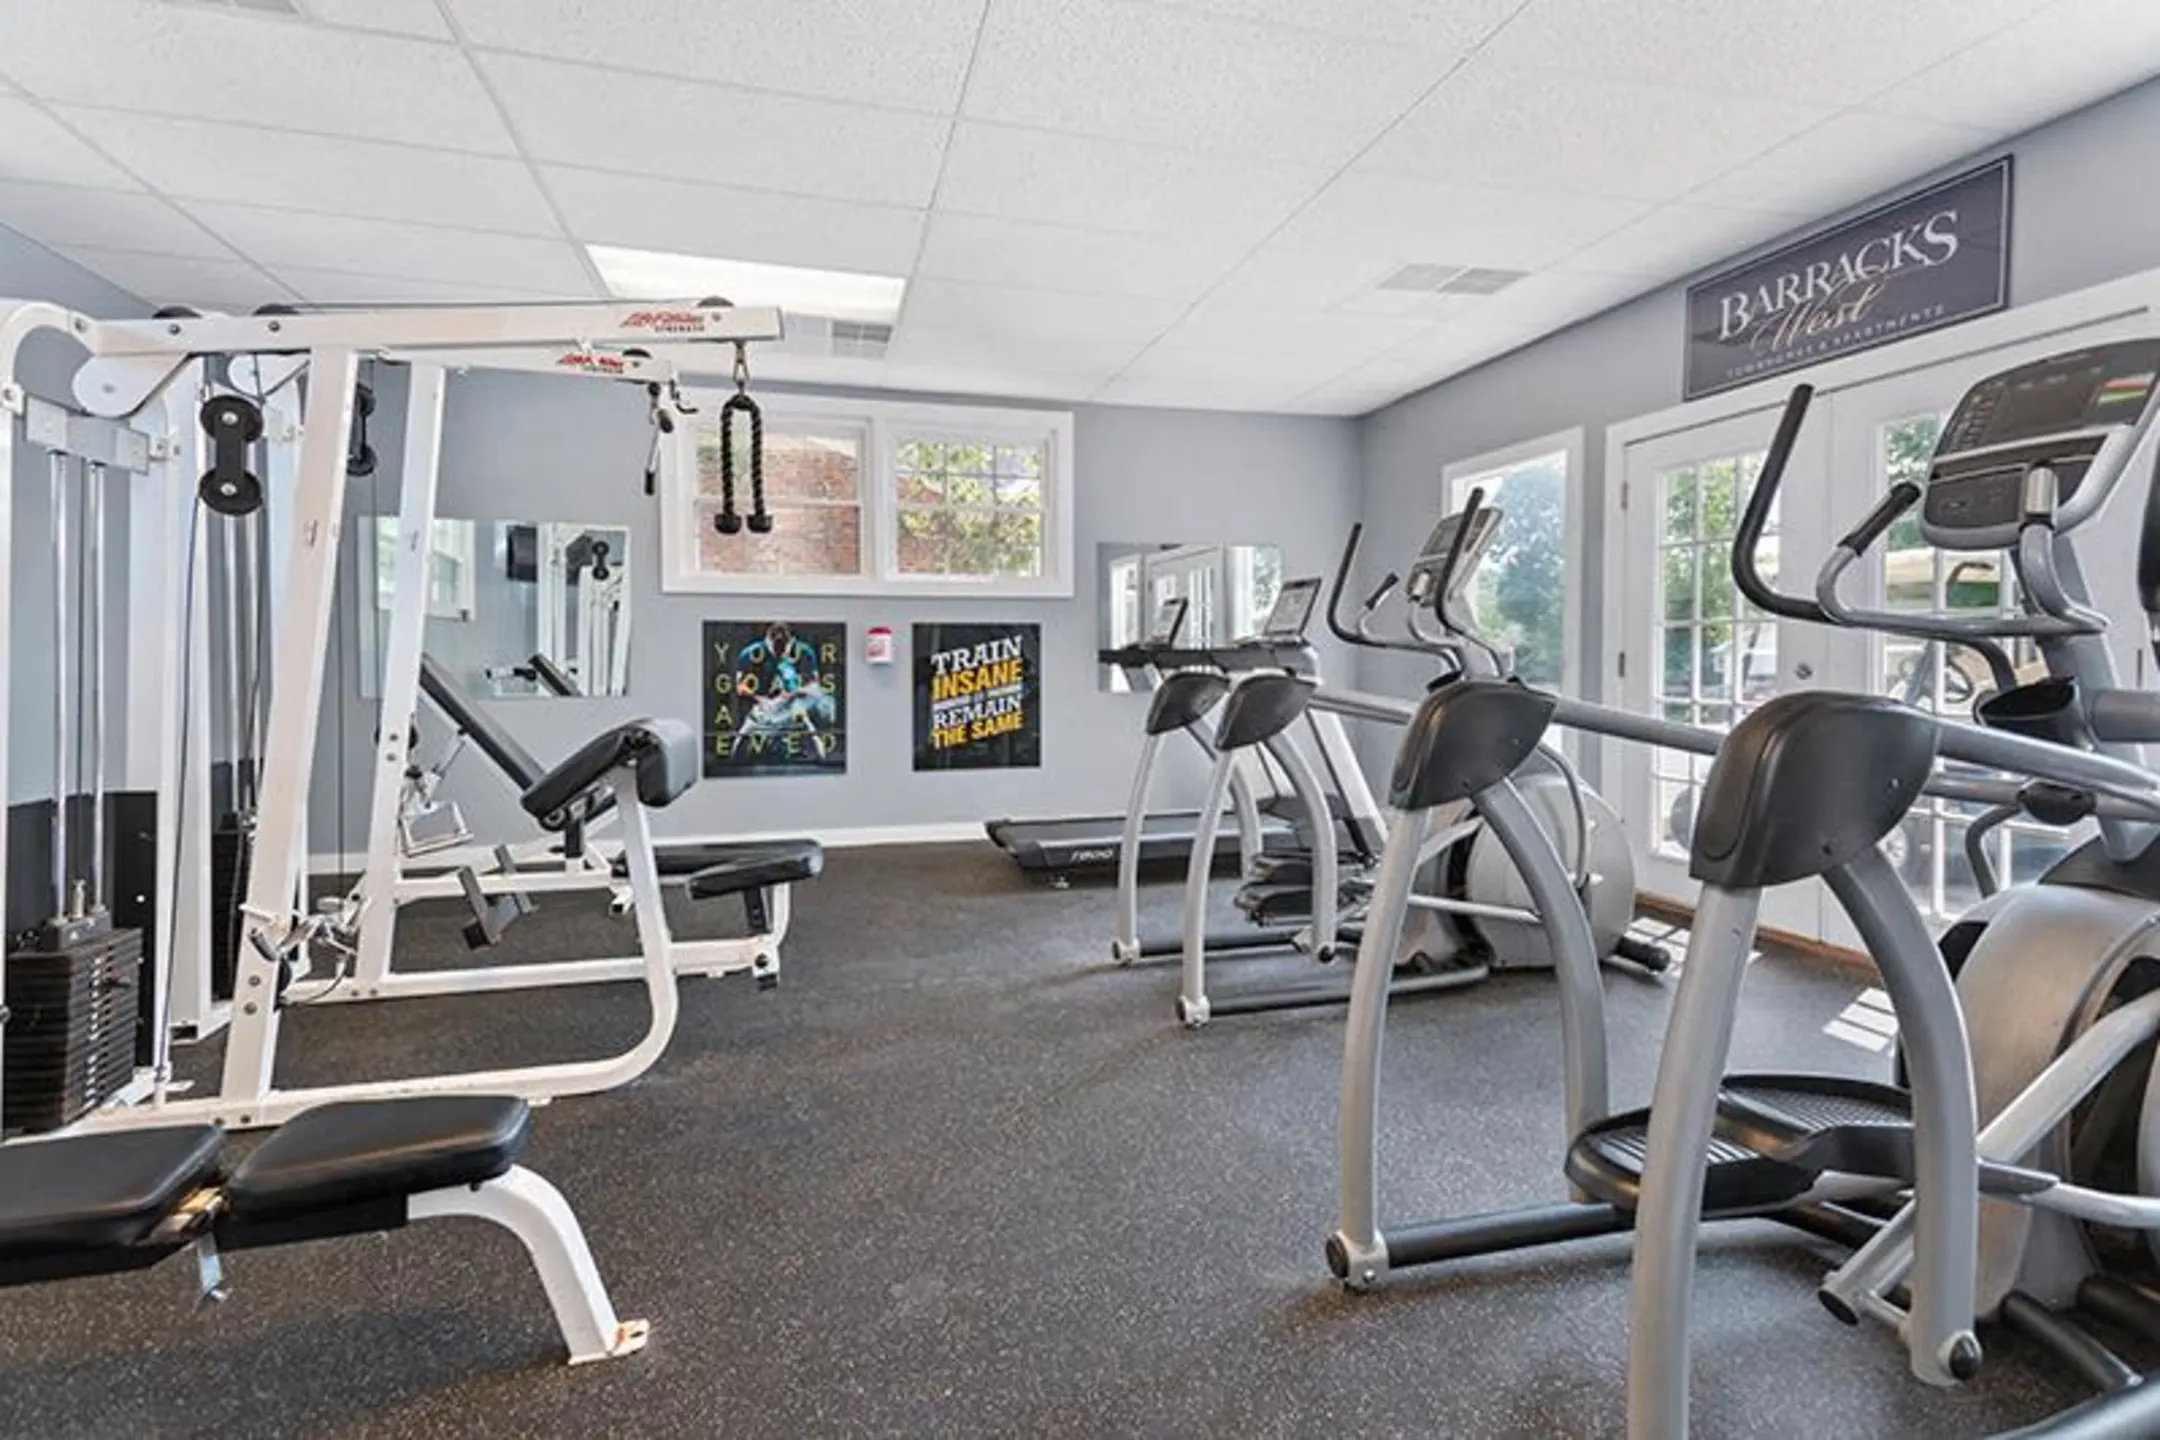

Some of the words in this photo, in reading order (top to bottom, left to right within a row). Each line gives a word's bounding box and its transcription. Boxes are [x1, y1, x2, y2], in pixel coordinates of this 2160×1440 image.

[1717, 210, 1959, 342] BARRACKS
[1750, 268, 1886, 351] West
[931, 634, 1023, 675] TRAIN
[932, 658, 1023, 701] INSANE
[932, 724, 968, 749] THE
[971, 710, 1023, 740] SAME
[933, 692, 1023, 728] REMAIN
